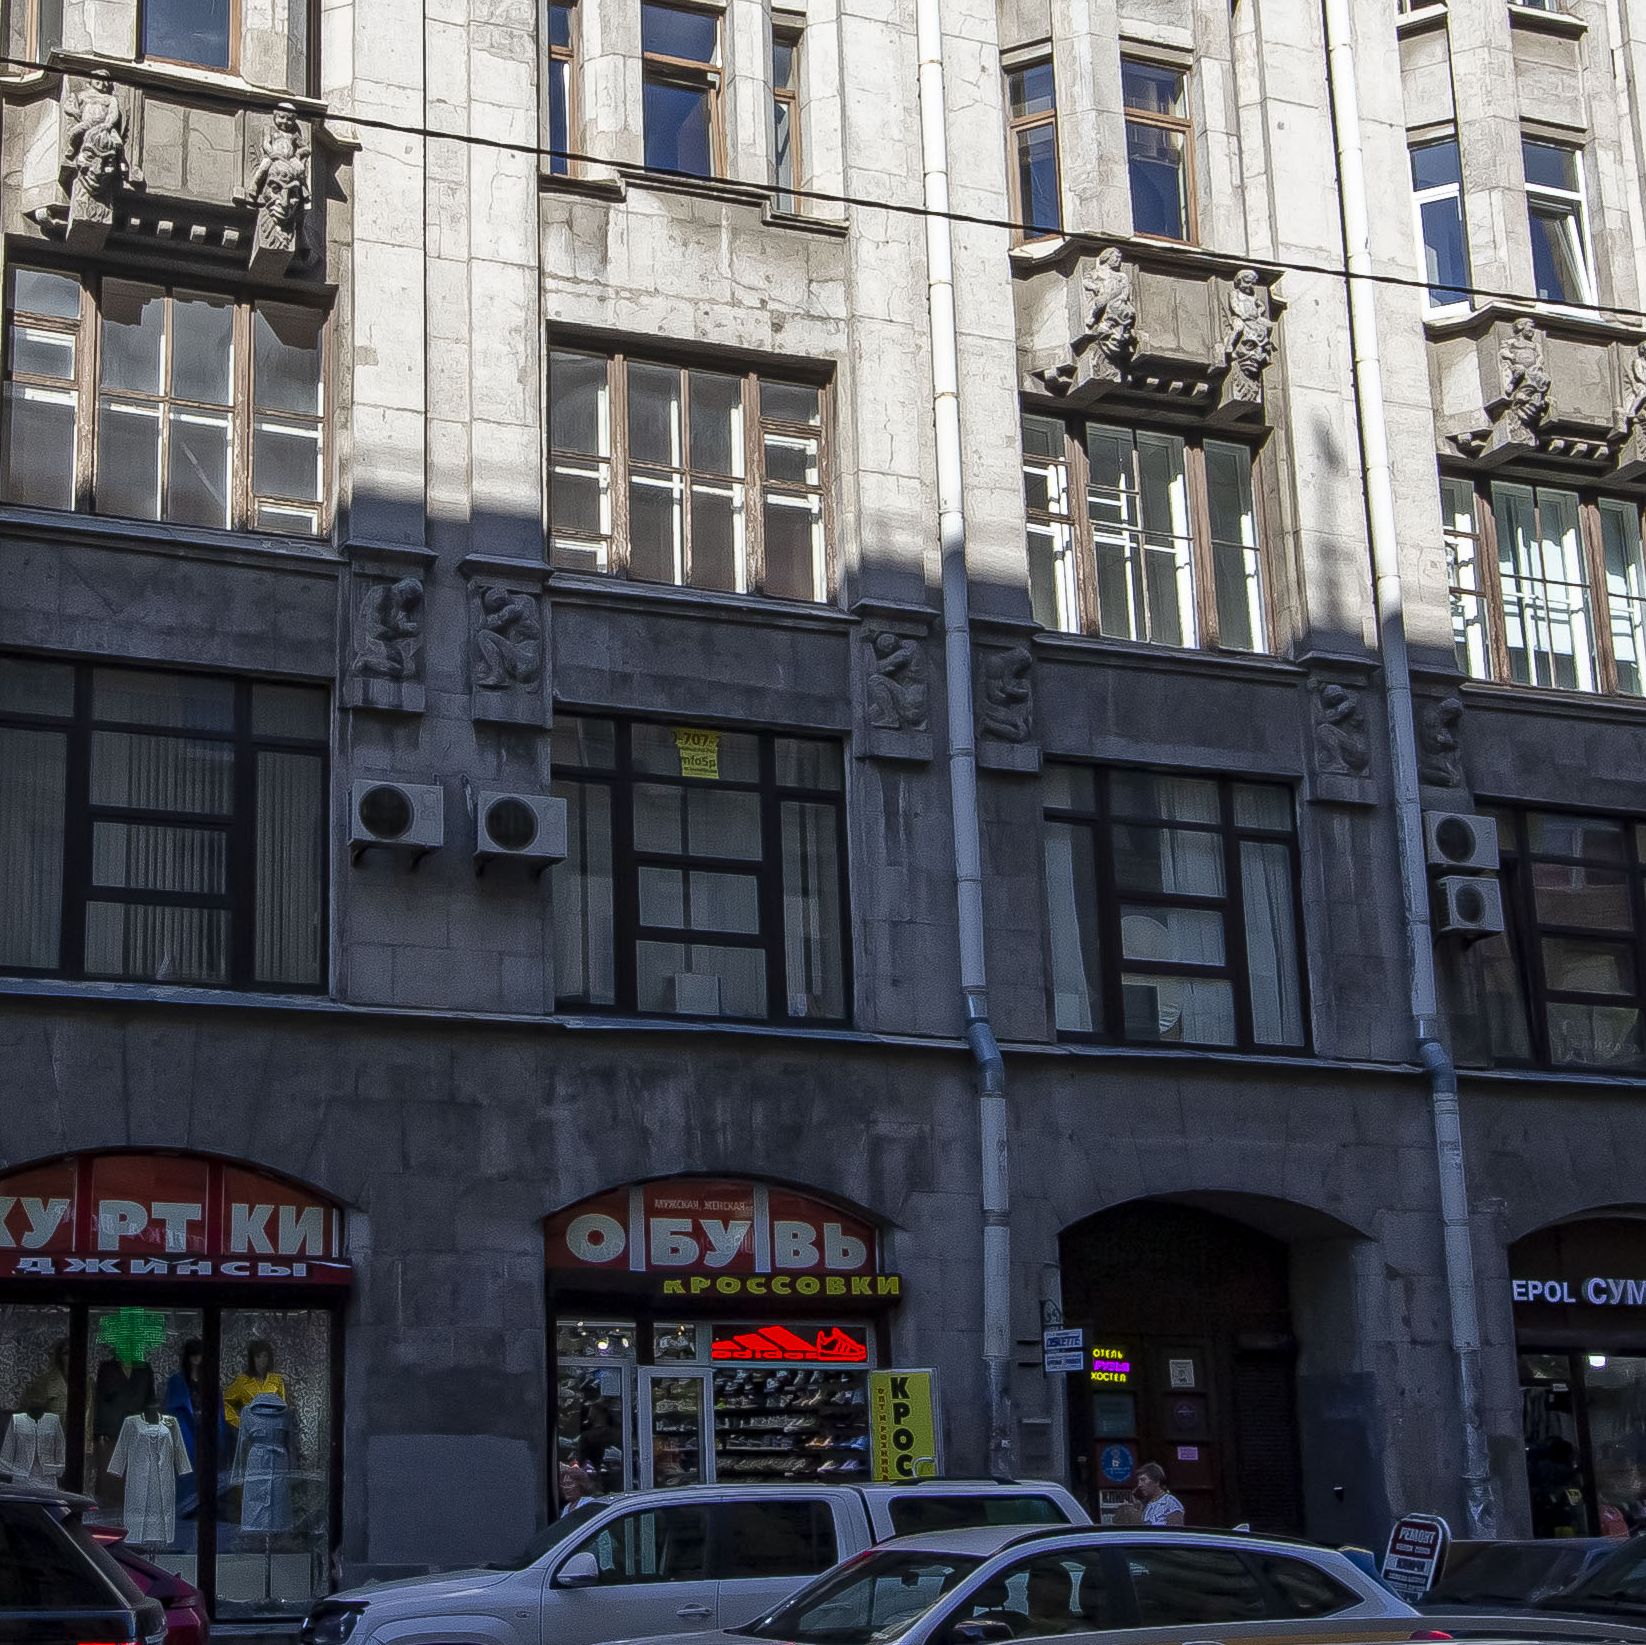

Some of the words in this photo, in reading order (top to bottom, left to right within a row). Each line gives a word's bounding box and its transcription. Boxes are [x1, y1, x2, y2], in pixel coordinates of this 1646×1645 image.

[565, 1213, 868, 1269] ОБУВЬ
[11, 1256, 308, 1278] ДЖИНСЫ
[663, 1275, 900, 1295] КРОССОВКИ
[1512, 1279, 1576, 1303] EPOL
[1092, 1348, 1124, 1359] ОТЕЛЬ
[1090, 1371, 1127, 1383] ХОСТЕЛ
